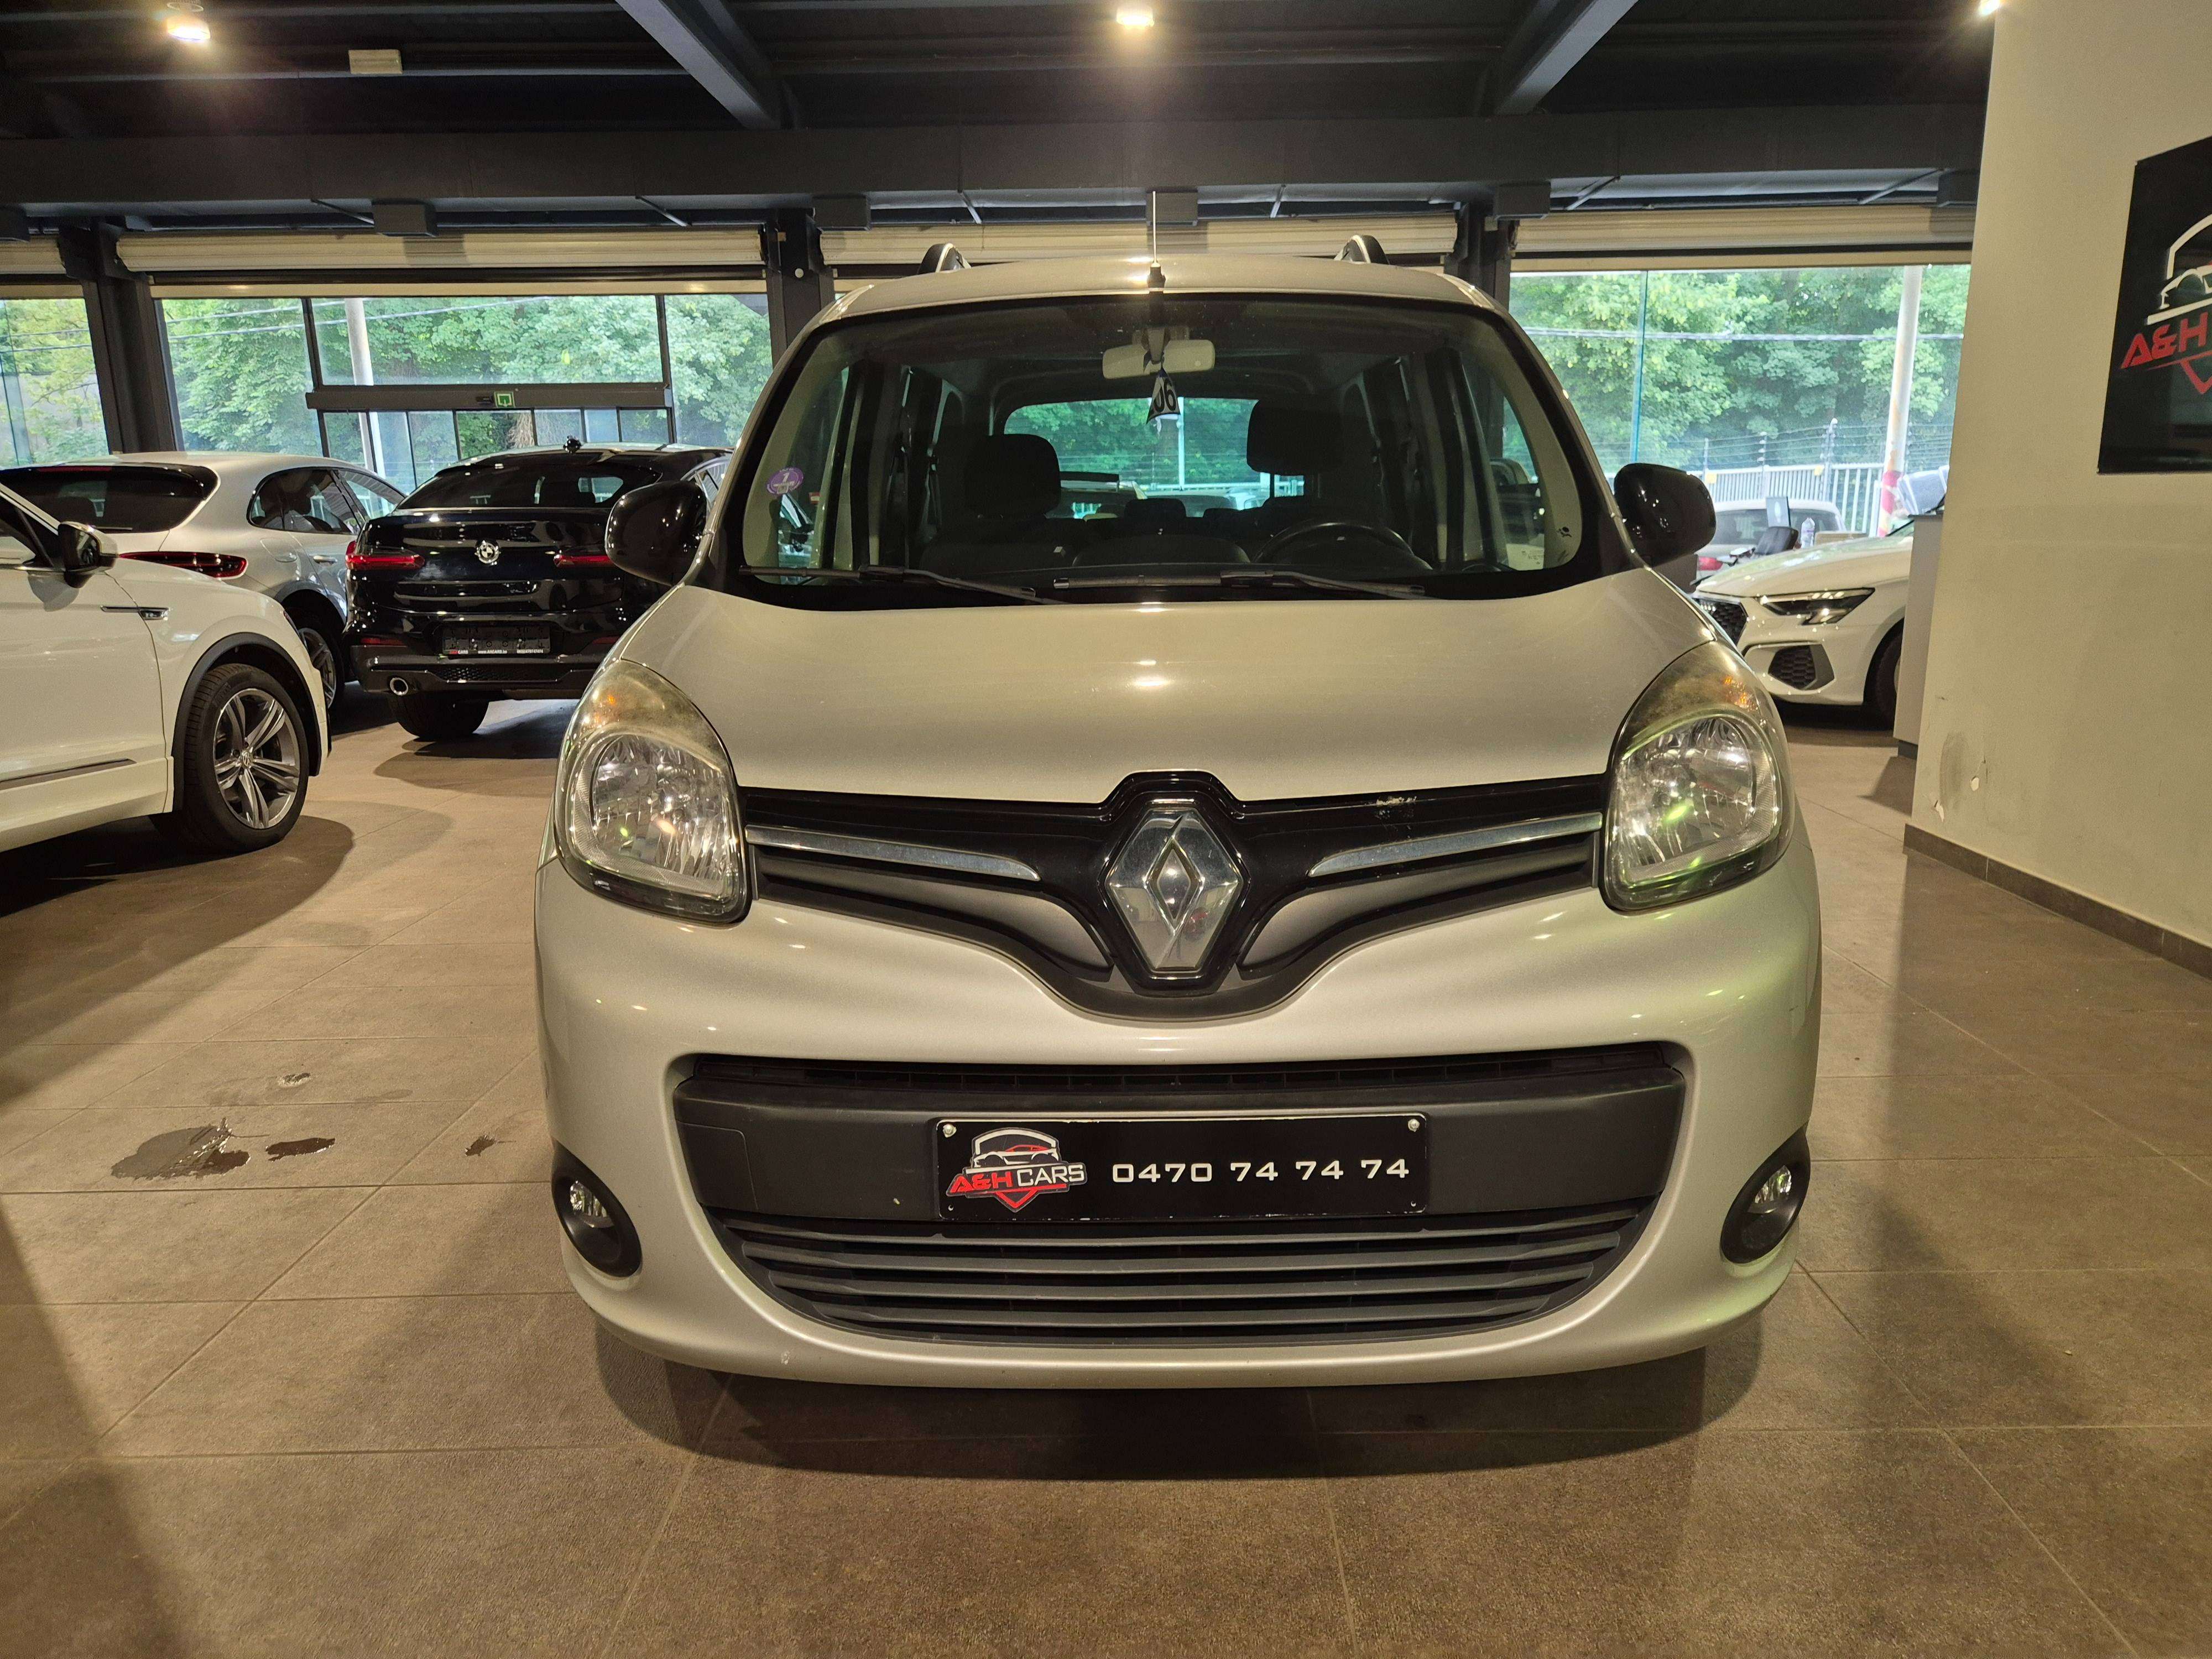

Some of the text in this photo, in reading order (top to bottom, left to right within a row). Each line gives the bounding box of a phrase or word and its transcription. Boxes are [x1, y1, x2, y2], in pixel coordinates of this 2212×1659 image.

[2121, 312, 2208, 369] A&H
[950, 1164, 1085, 1193] A&H CARS
[1112, 1159, 1410, 1183] 0470 74 74 74
